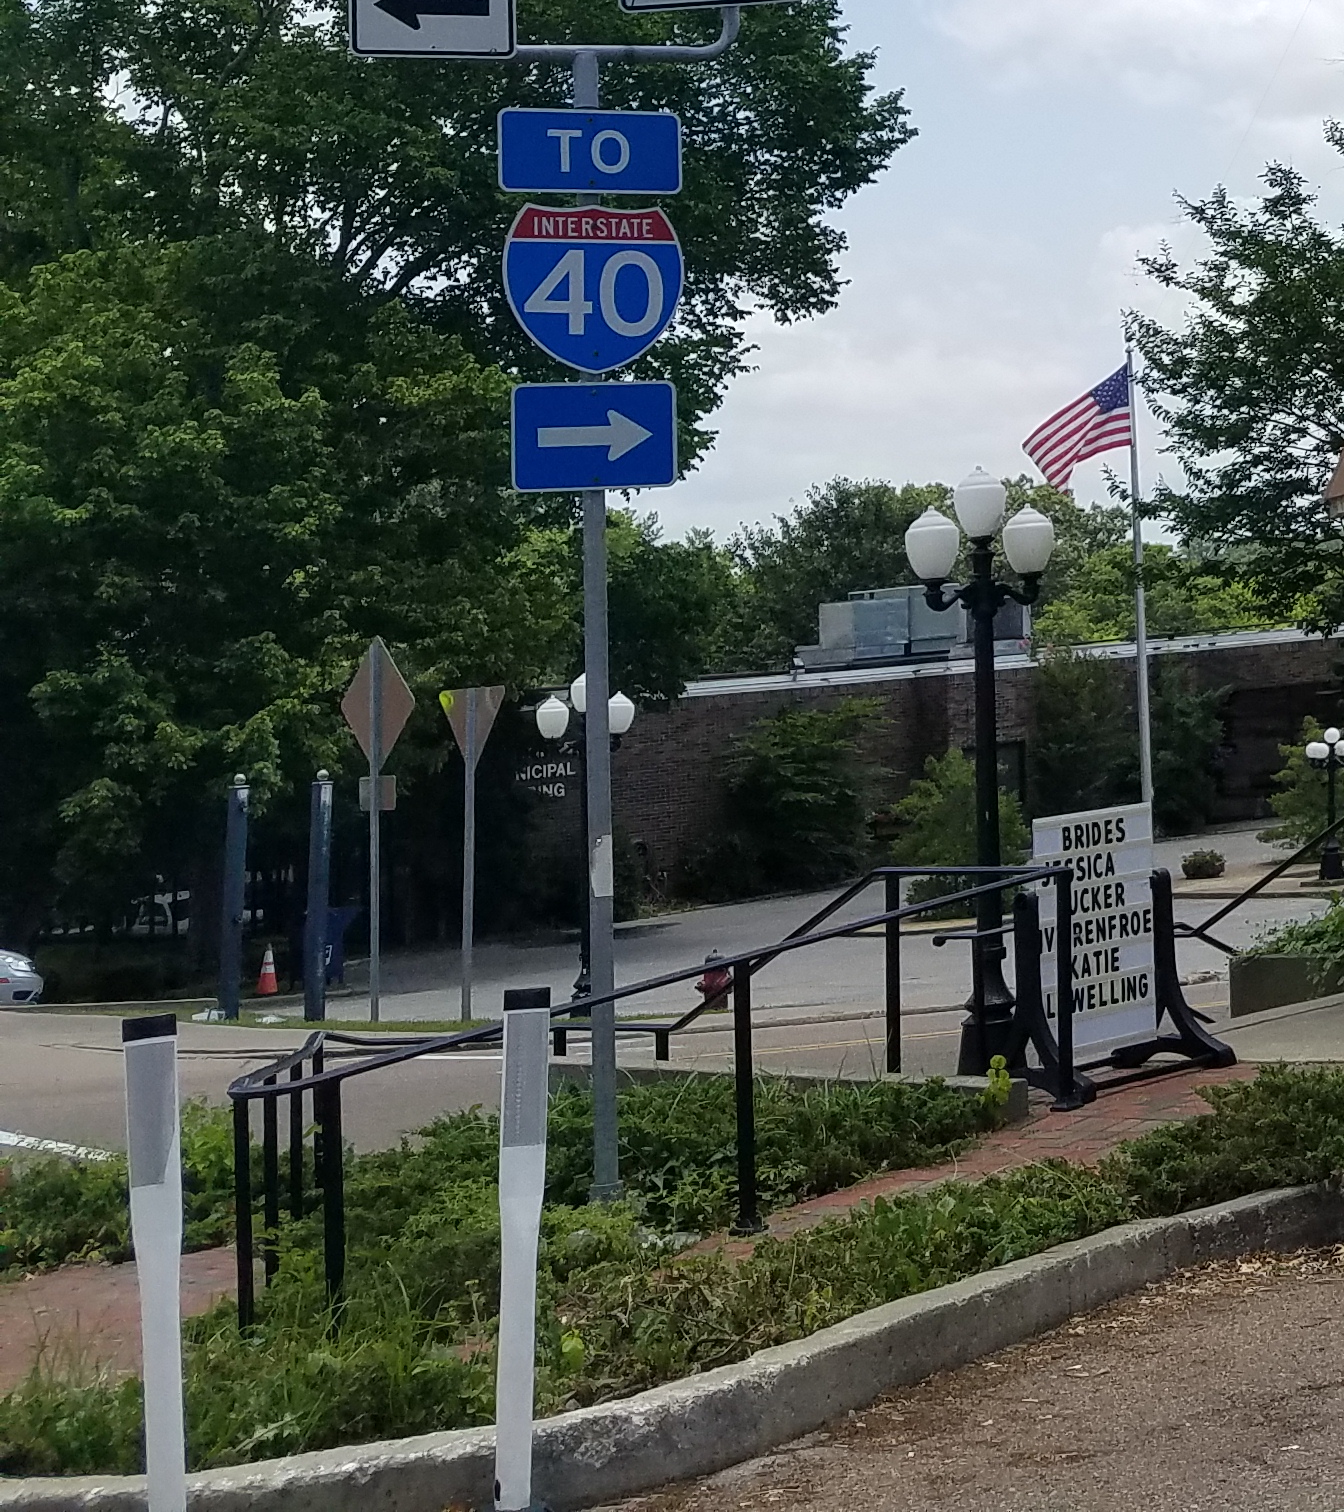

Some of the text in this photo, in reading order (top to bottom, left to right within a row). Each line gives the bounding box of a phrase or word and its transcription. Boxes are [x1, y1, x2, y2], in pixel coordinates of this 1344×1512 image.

[547, 129, 630, 174] TO
[533, 216, 654, 239] INTERSTATE
[524, 249, 664, 337] 40
[1061, 817, 1126, 851] BRIDES
